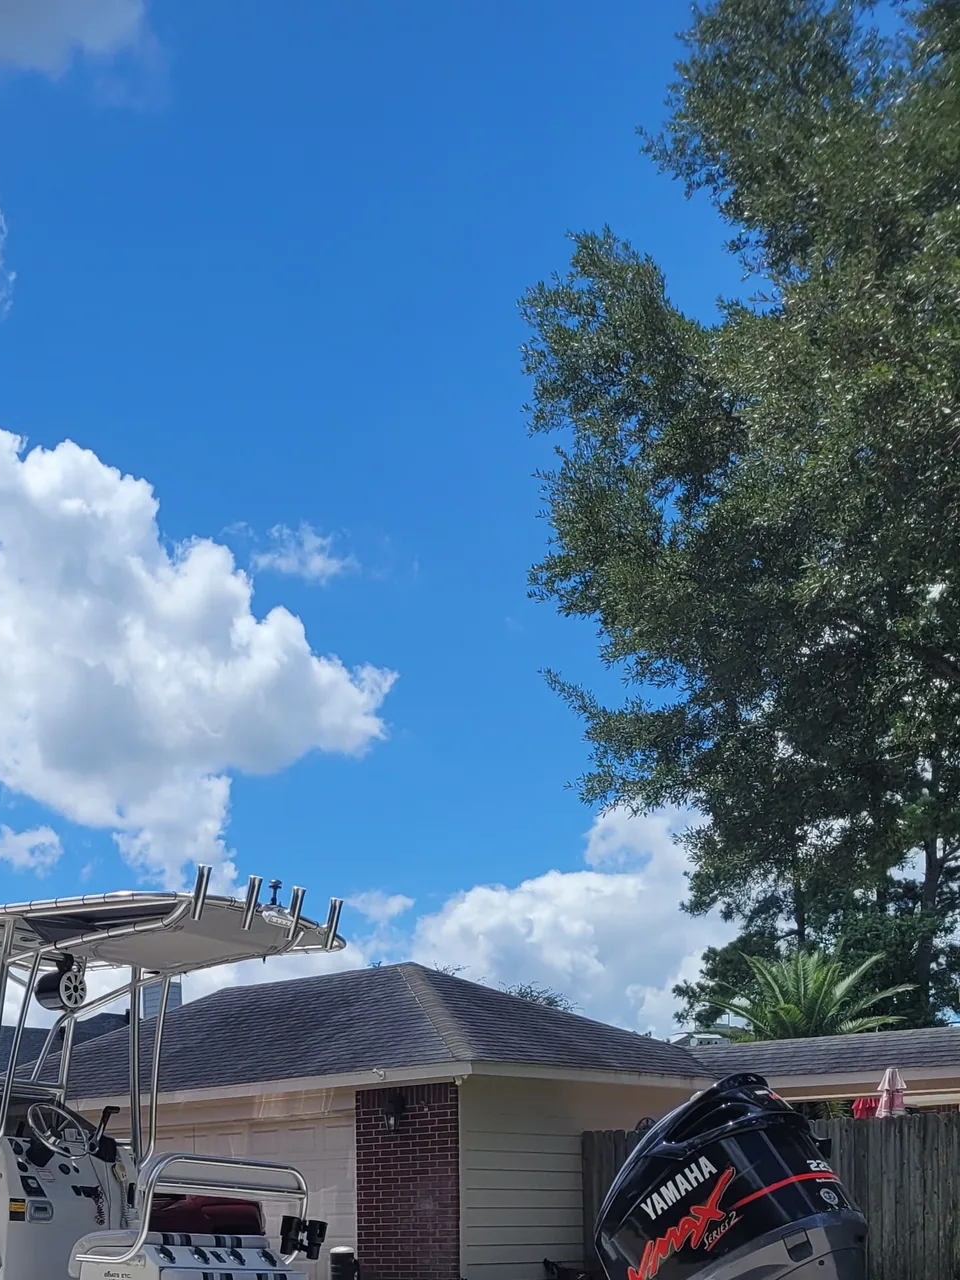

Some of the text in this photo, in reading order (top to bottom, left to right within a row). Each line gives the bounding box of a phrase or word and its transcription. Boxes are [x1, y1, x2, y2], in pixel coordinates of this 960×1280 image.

[640, 1156, 718, 1220] YAMAHA
[704, 1210, 739, 1250] SERIES 2
